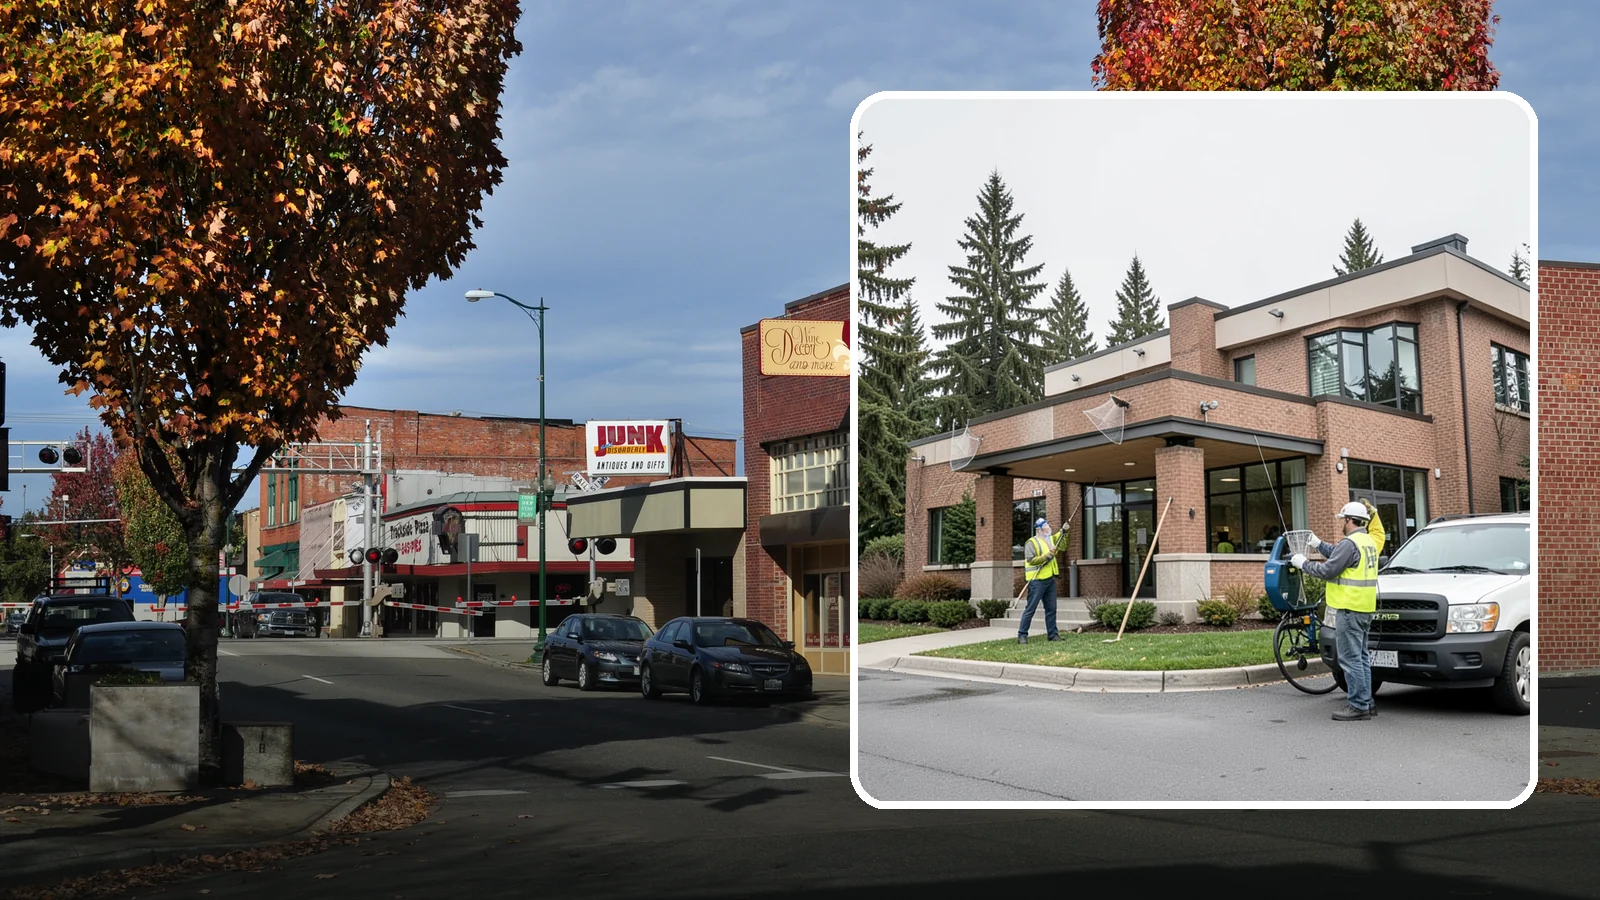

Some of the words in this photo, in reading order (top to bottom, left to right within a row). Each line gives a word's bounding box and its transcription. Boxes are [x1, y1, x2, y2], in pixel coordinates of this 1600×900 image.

[765, 328, 831, 366] Decor
[595, 425, 664, 457] JUNK
[607, 445, 645, 454] DISORDERLY
[597, 461, 628, 470] ANTIQUES
[631, 461, 644, 469] AND
[647, 460, 665, 469] GIFTS
[390, 521, 413, 540] Trackside
[414, 519, 429, 534] Pizza
